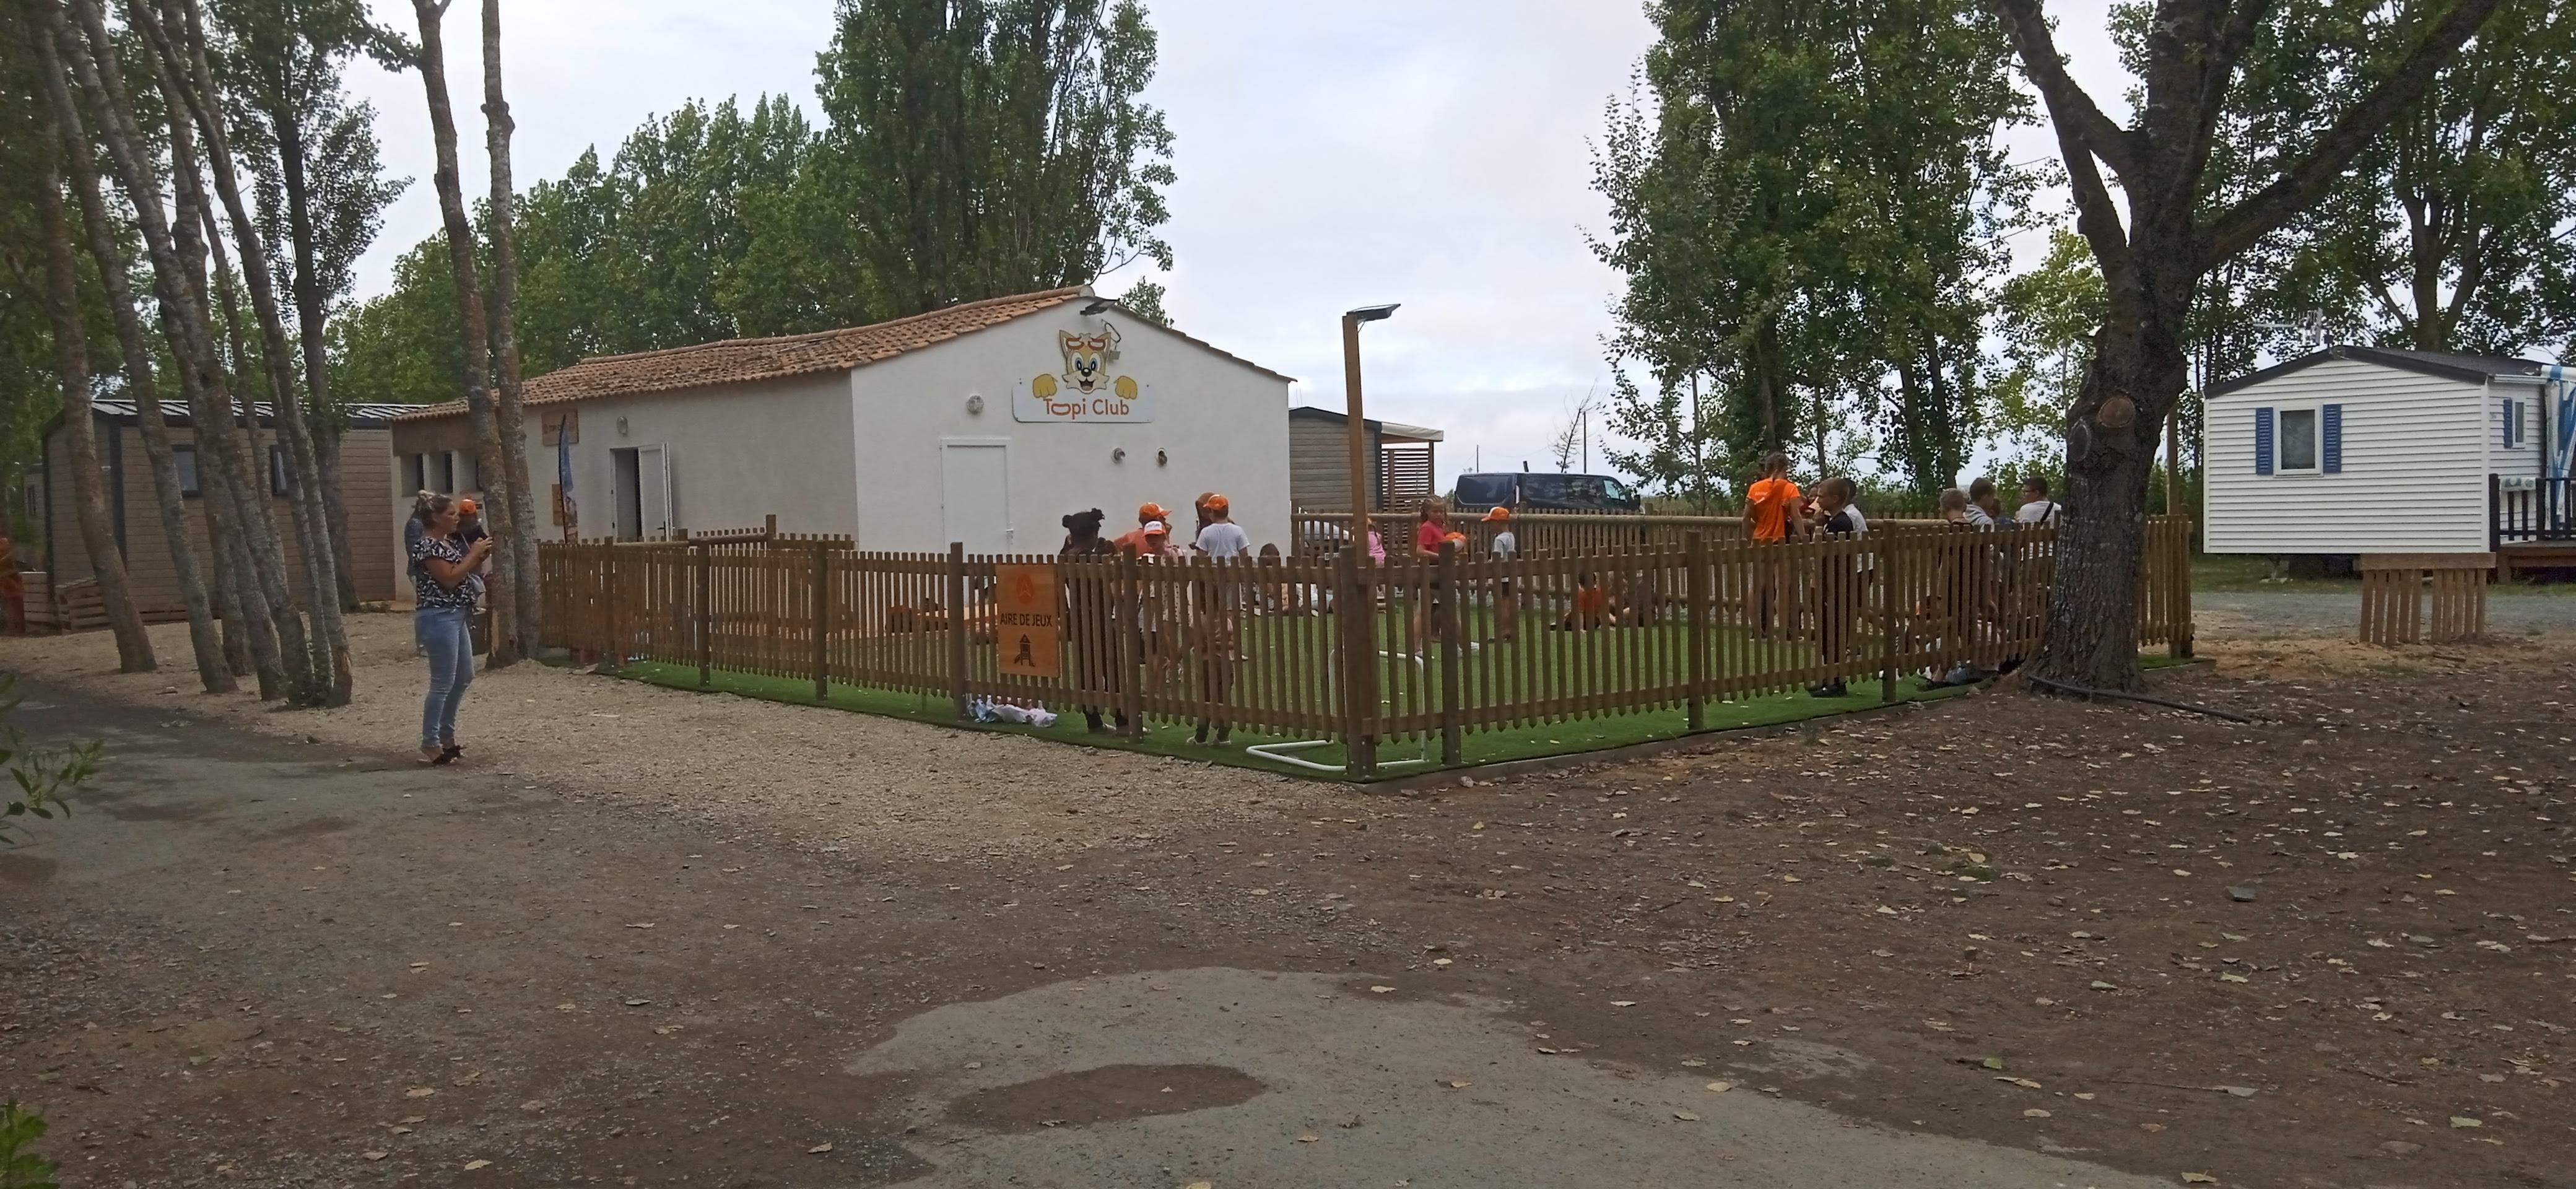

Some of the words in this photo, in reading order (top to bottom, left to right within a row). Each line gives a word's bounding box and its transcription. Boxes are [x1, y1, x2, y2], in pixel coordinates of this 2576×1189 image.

[1043, 398, 1086, 420] Topi
[1092, 399, 1129, 415] Club
[1000, 613, 1017, 625] AIRE
[1019, 614, 1030, 626] DE
[1032, 614, 1053, 627] JEUX
